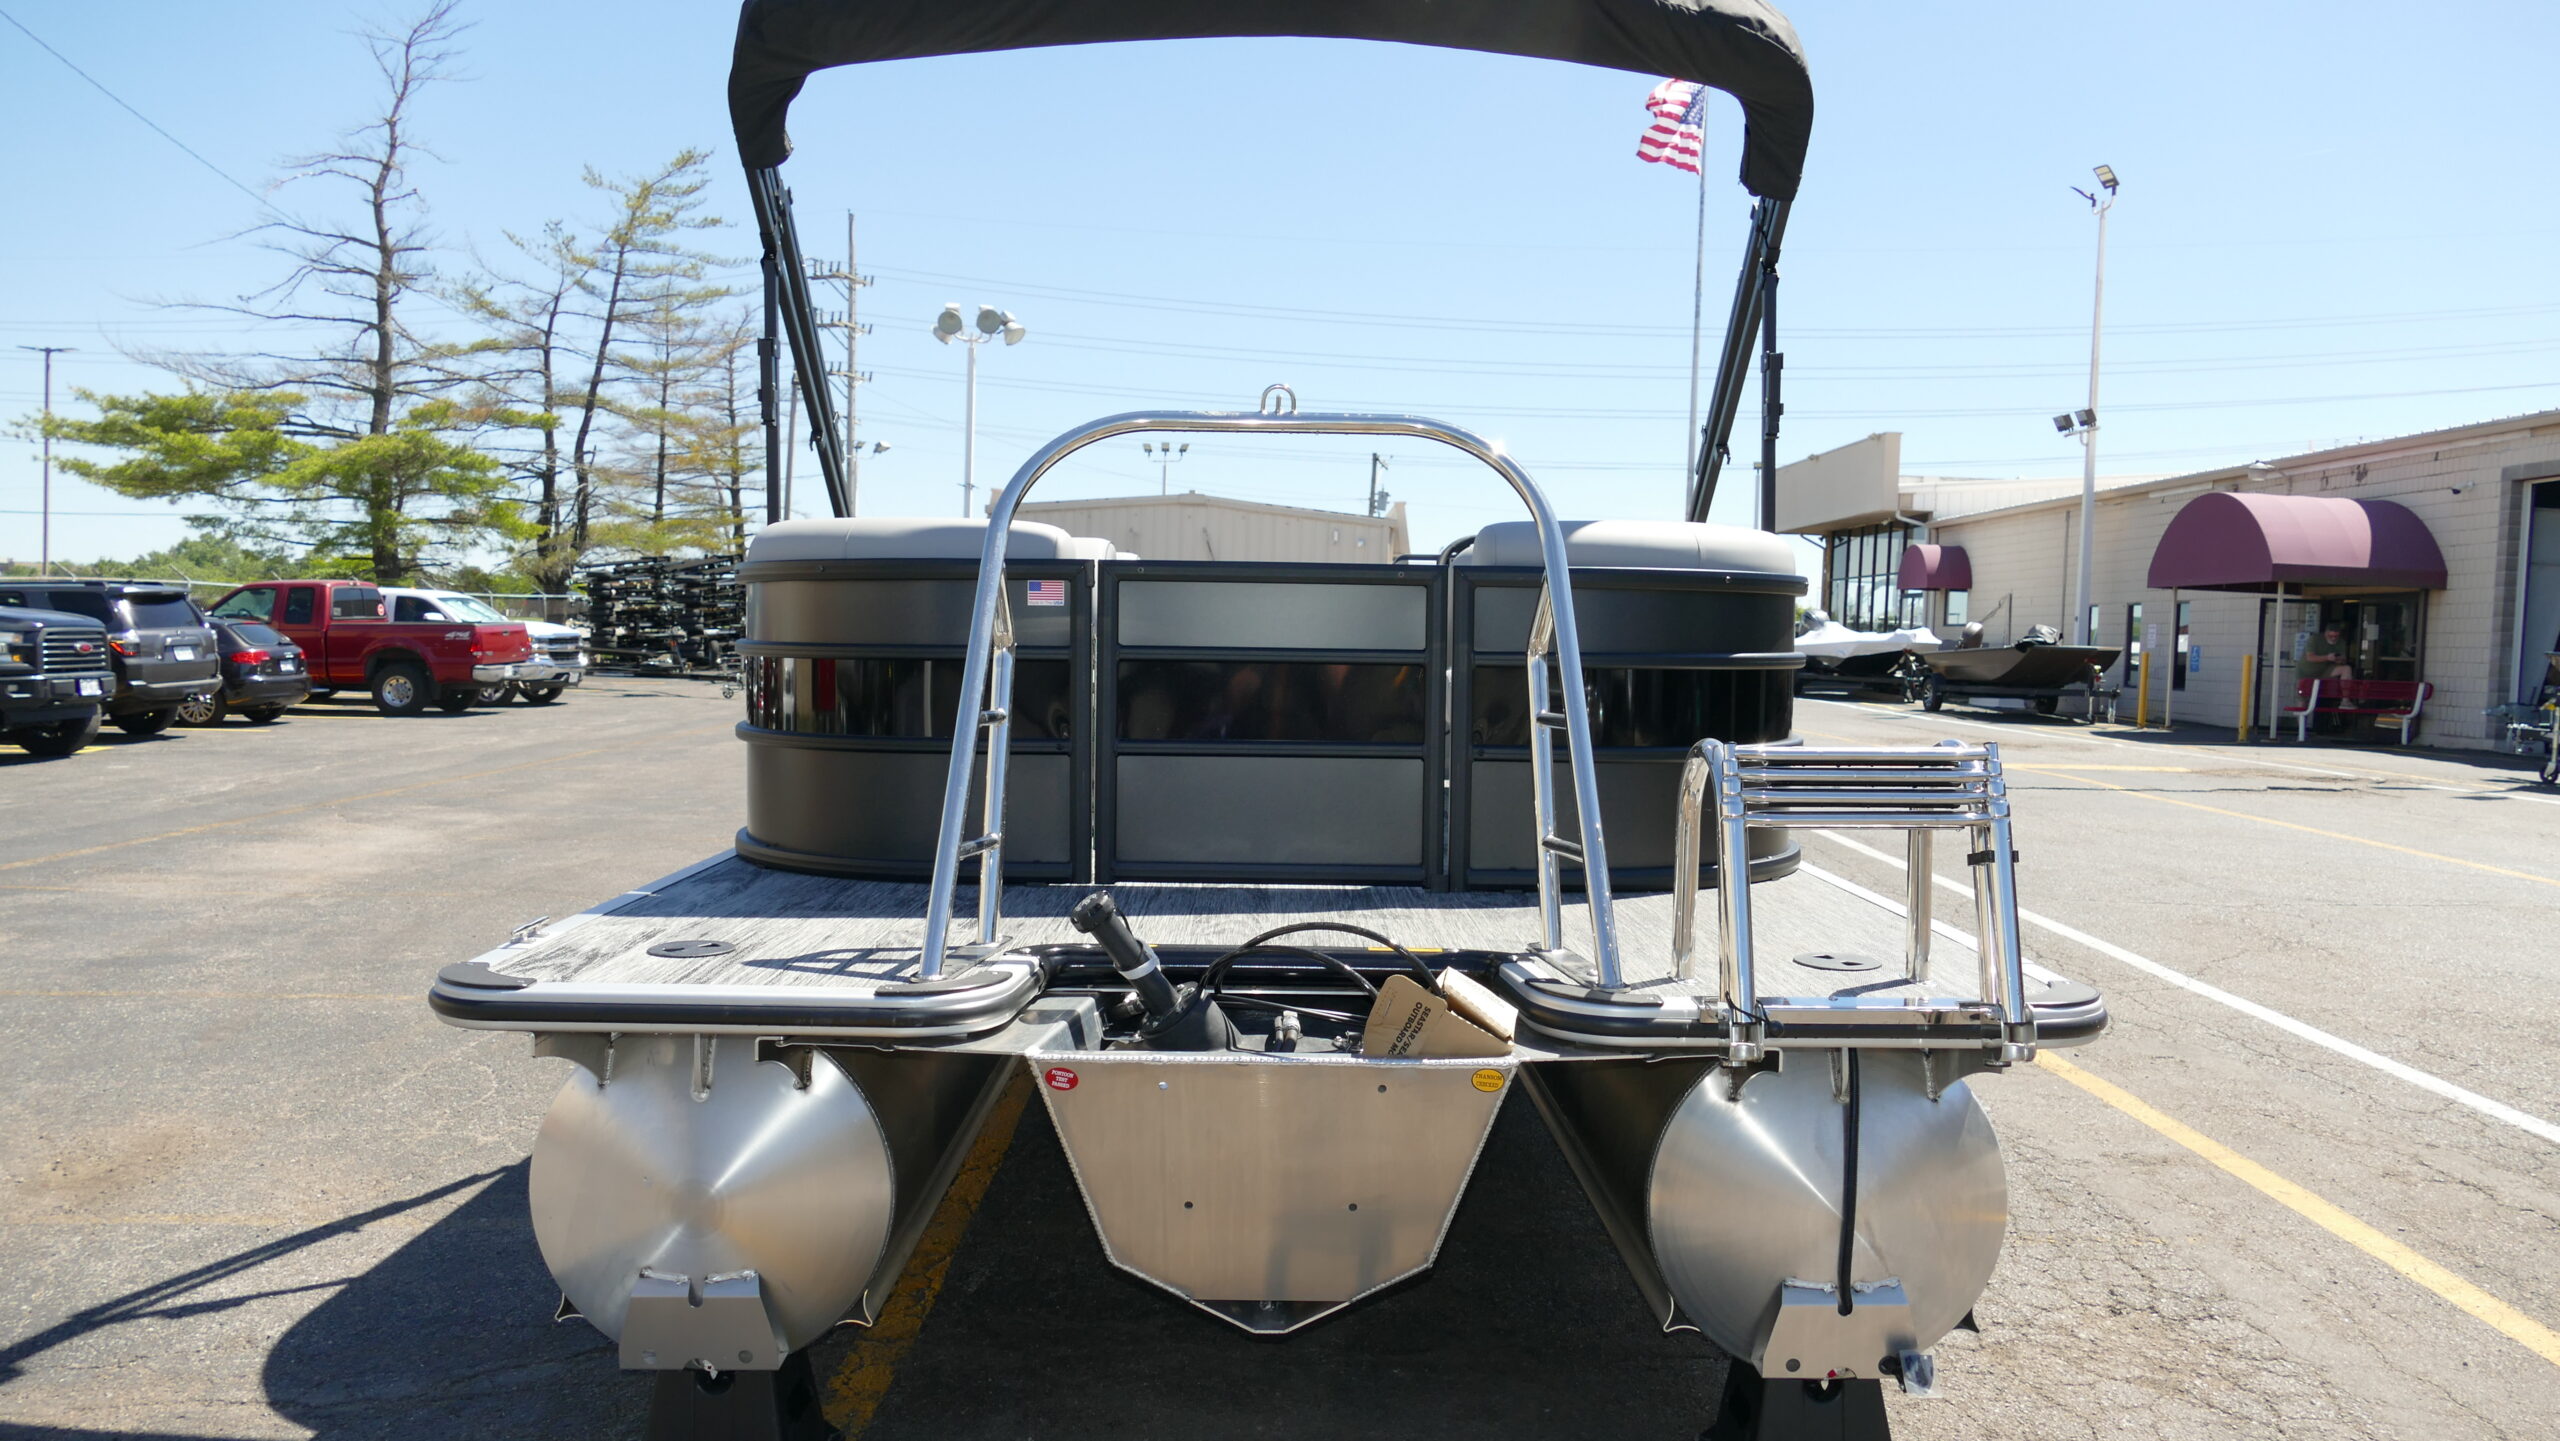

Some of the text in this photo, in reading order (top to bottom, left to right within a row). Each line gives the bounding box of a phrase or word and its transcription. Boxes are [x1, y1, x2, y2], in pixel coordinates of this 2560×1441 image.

[1395, 1001, 1423, 1043] OUTBOARD
[1051, 1069, 1075, 1078] PONTOON
[1475, 1073, 1503, 1081] TRANSOM
